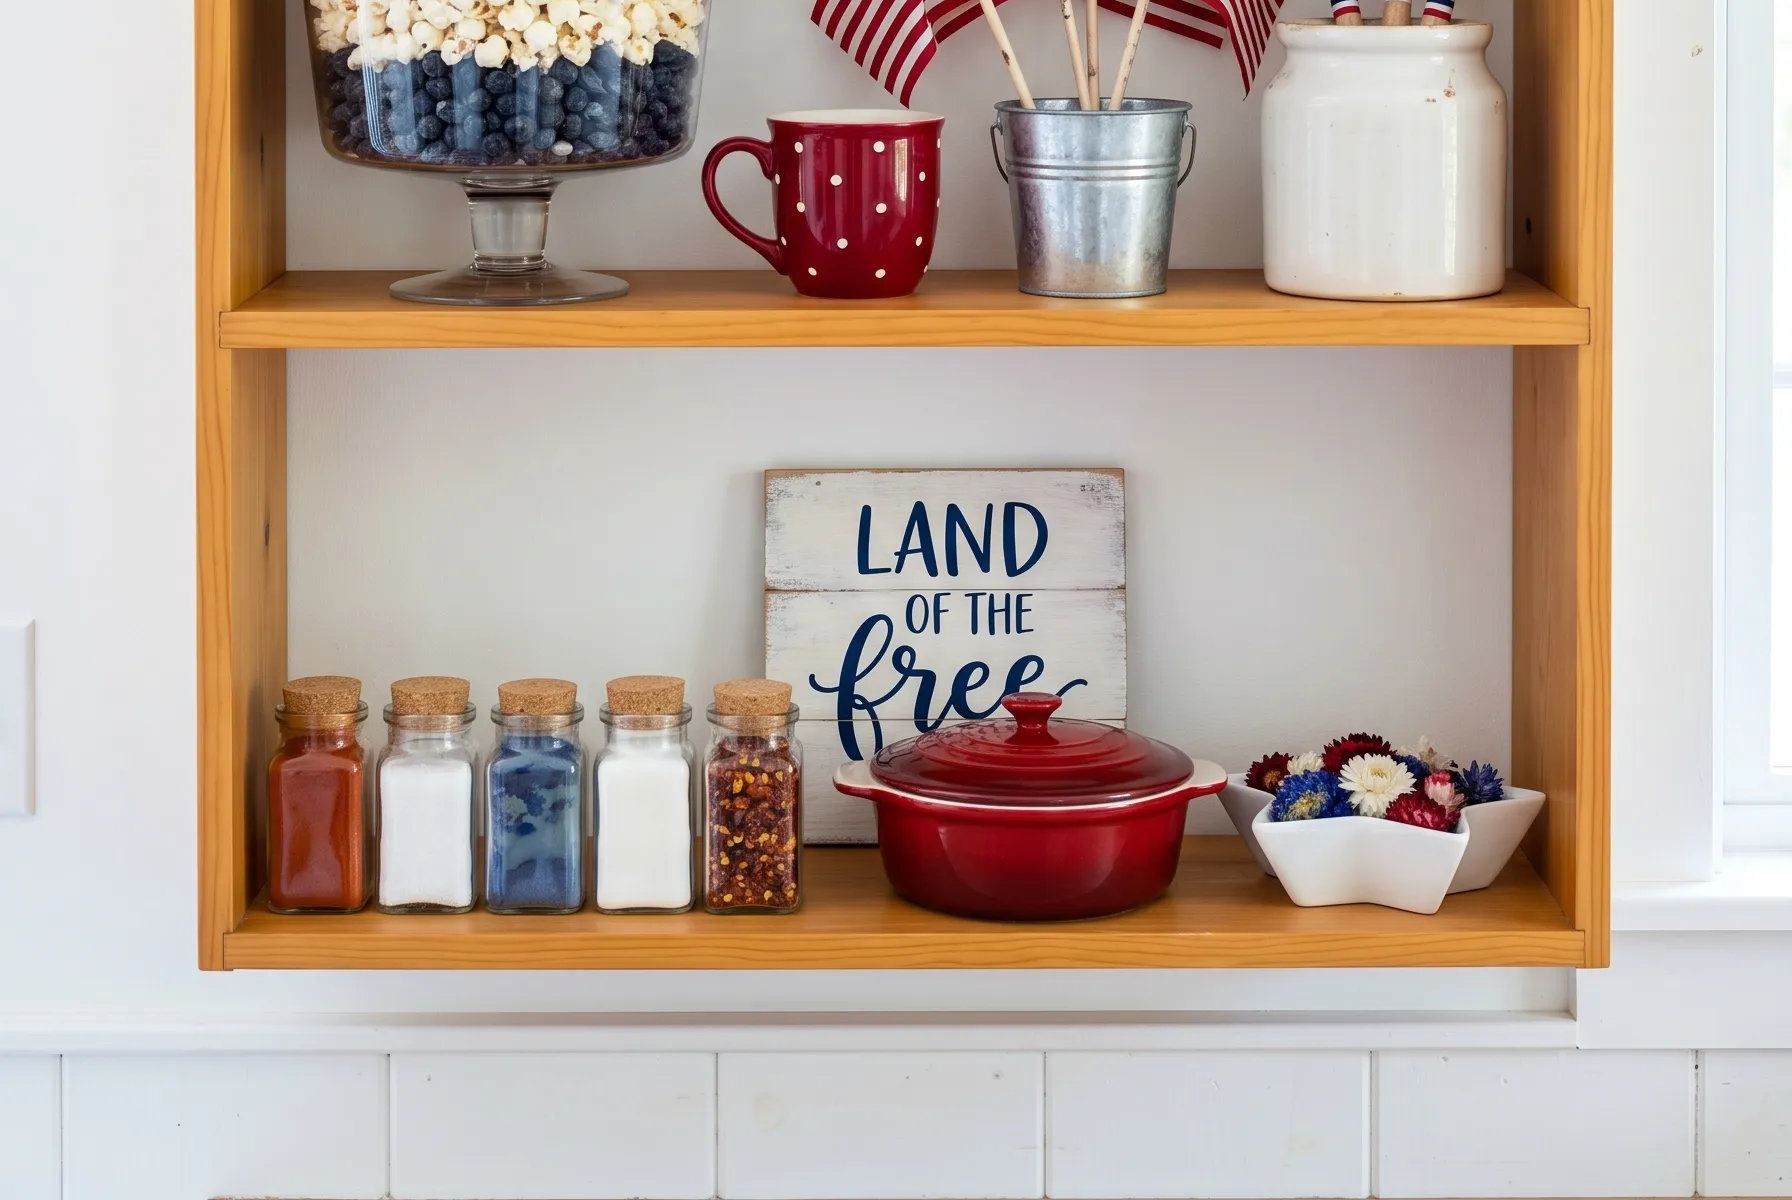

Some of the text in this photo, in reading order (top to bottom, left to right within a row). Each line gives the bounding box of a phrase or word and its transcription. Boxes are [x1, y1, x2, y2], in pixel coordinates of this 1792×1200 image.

[857, 500, 1048, 577] LAND
[905, 592, 1034, 635] OF THE
[809, 613, 1088, 761] free
